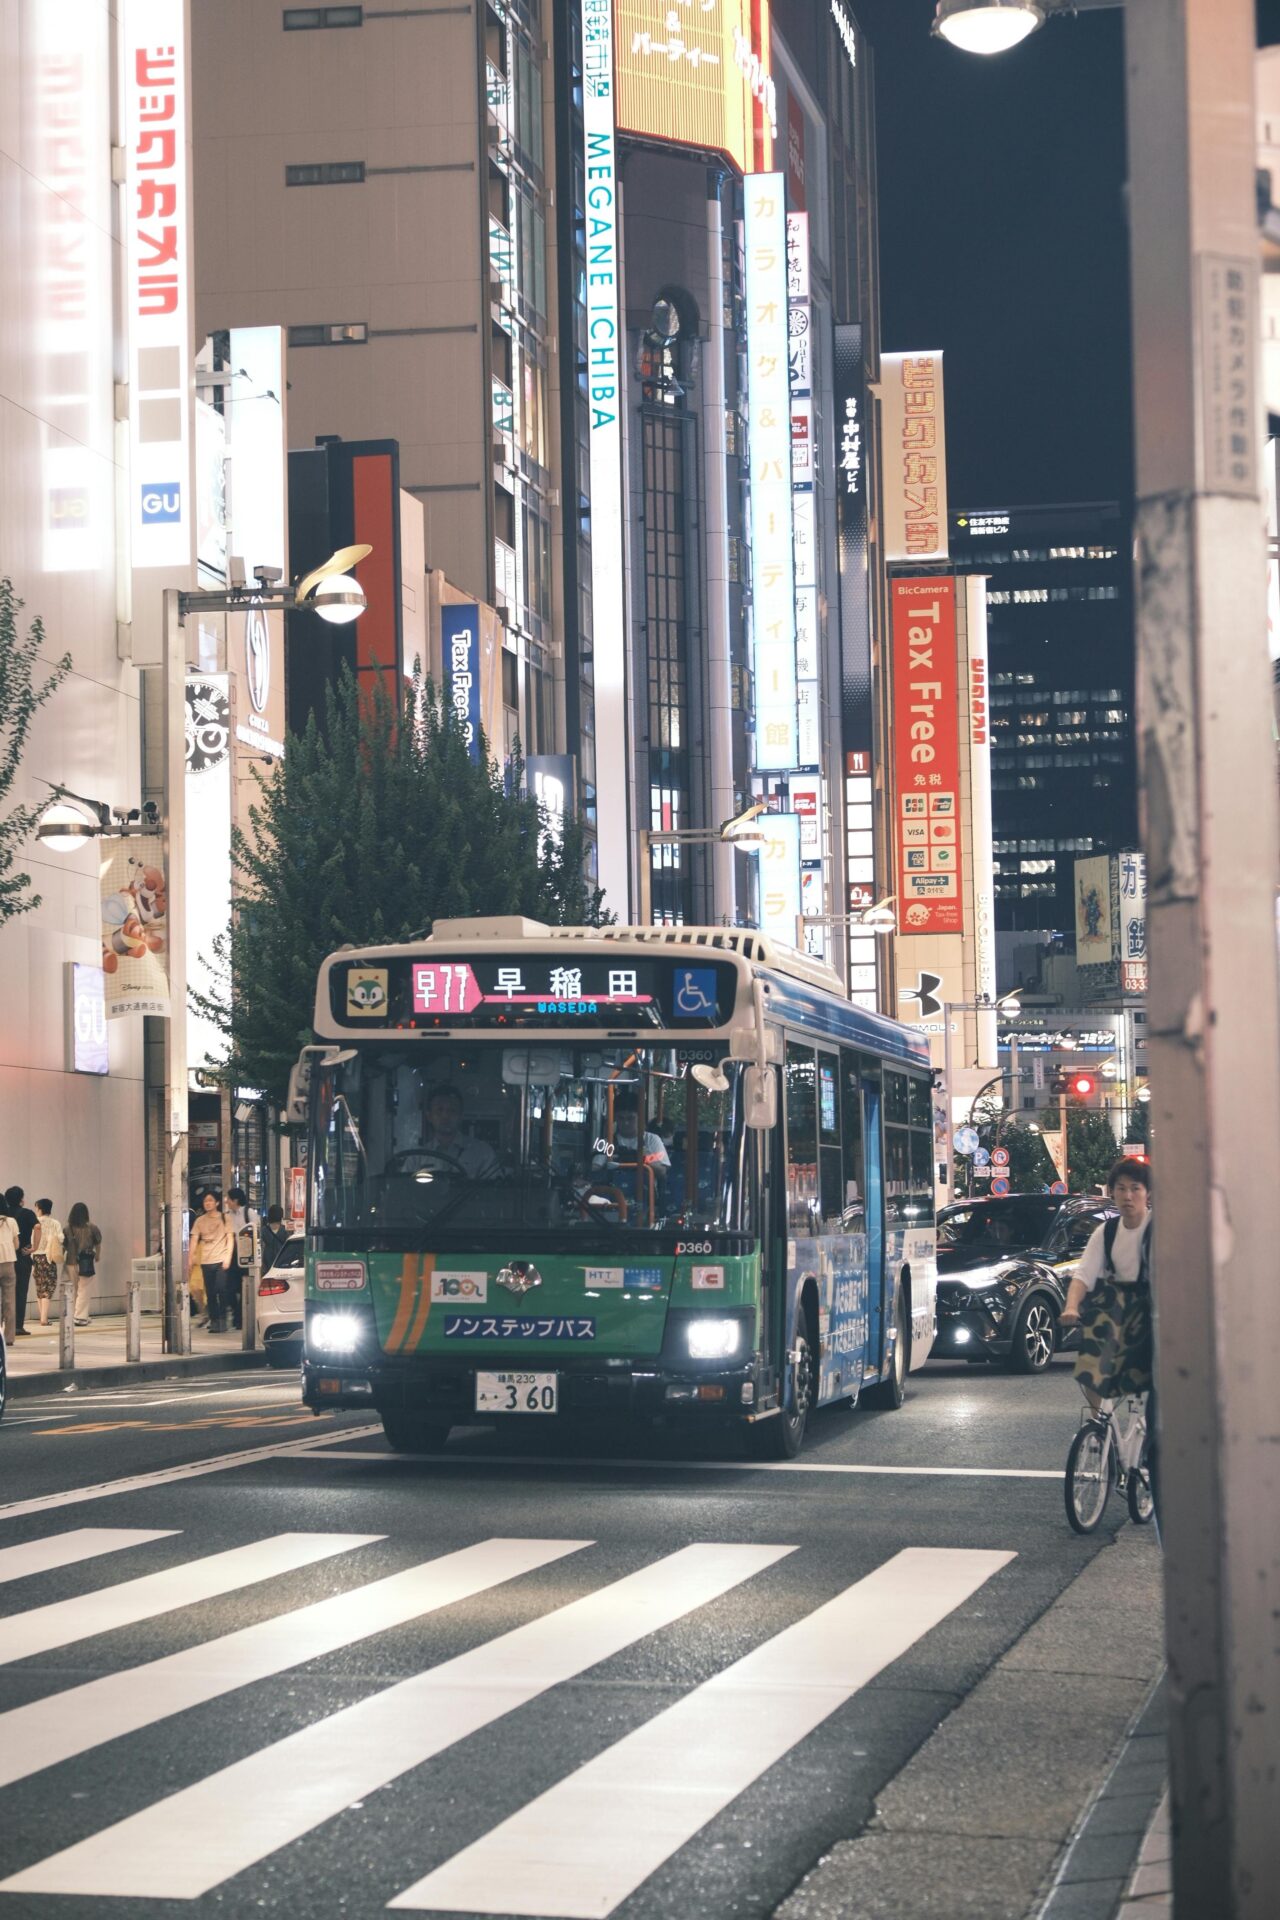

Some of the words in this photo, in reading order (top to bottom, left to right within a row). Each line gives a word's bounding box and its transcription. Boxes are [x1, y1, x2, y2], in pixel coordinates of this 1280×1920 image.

[631, 32, 719, 67] パーティー
[135, 45, 179, 315] ビックカメラ
[588, 133, 613, 286] MEGANE
[591, 306, 616, 430] ICHIBA
[903, 358, 938, 554] ビックカメラ
[143, 493, 180, 513] GU
[969, 517, 1010, 526] 住友不動産
[898, 586, 949, 595] BicCamera
[452, 631, 470, 669] Tax
[908, 602, 940, 669] Tax
[454, 673, 471, 719] Free
[910, 682, 942, 763] Free
[914, 774, 942, 785] 免税
[415, 965, 468, 1011] 早77
[494, 967, 638, 999] 早稲田
[112, 1002, 165, 1014] 新宿大通商店街
[537, 1002, 597, 1013] WASEDA
[679, 1051, 712, 1060] D360
[677, 1243, 711, 1253] D360
[445, 1318, 595, 1337] ノンステップバス
